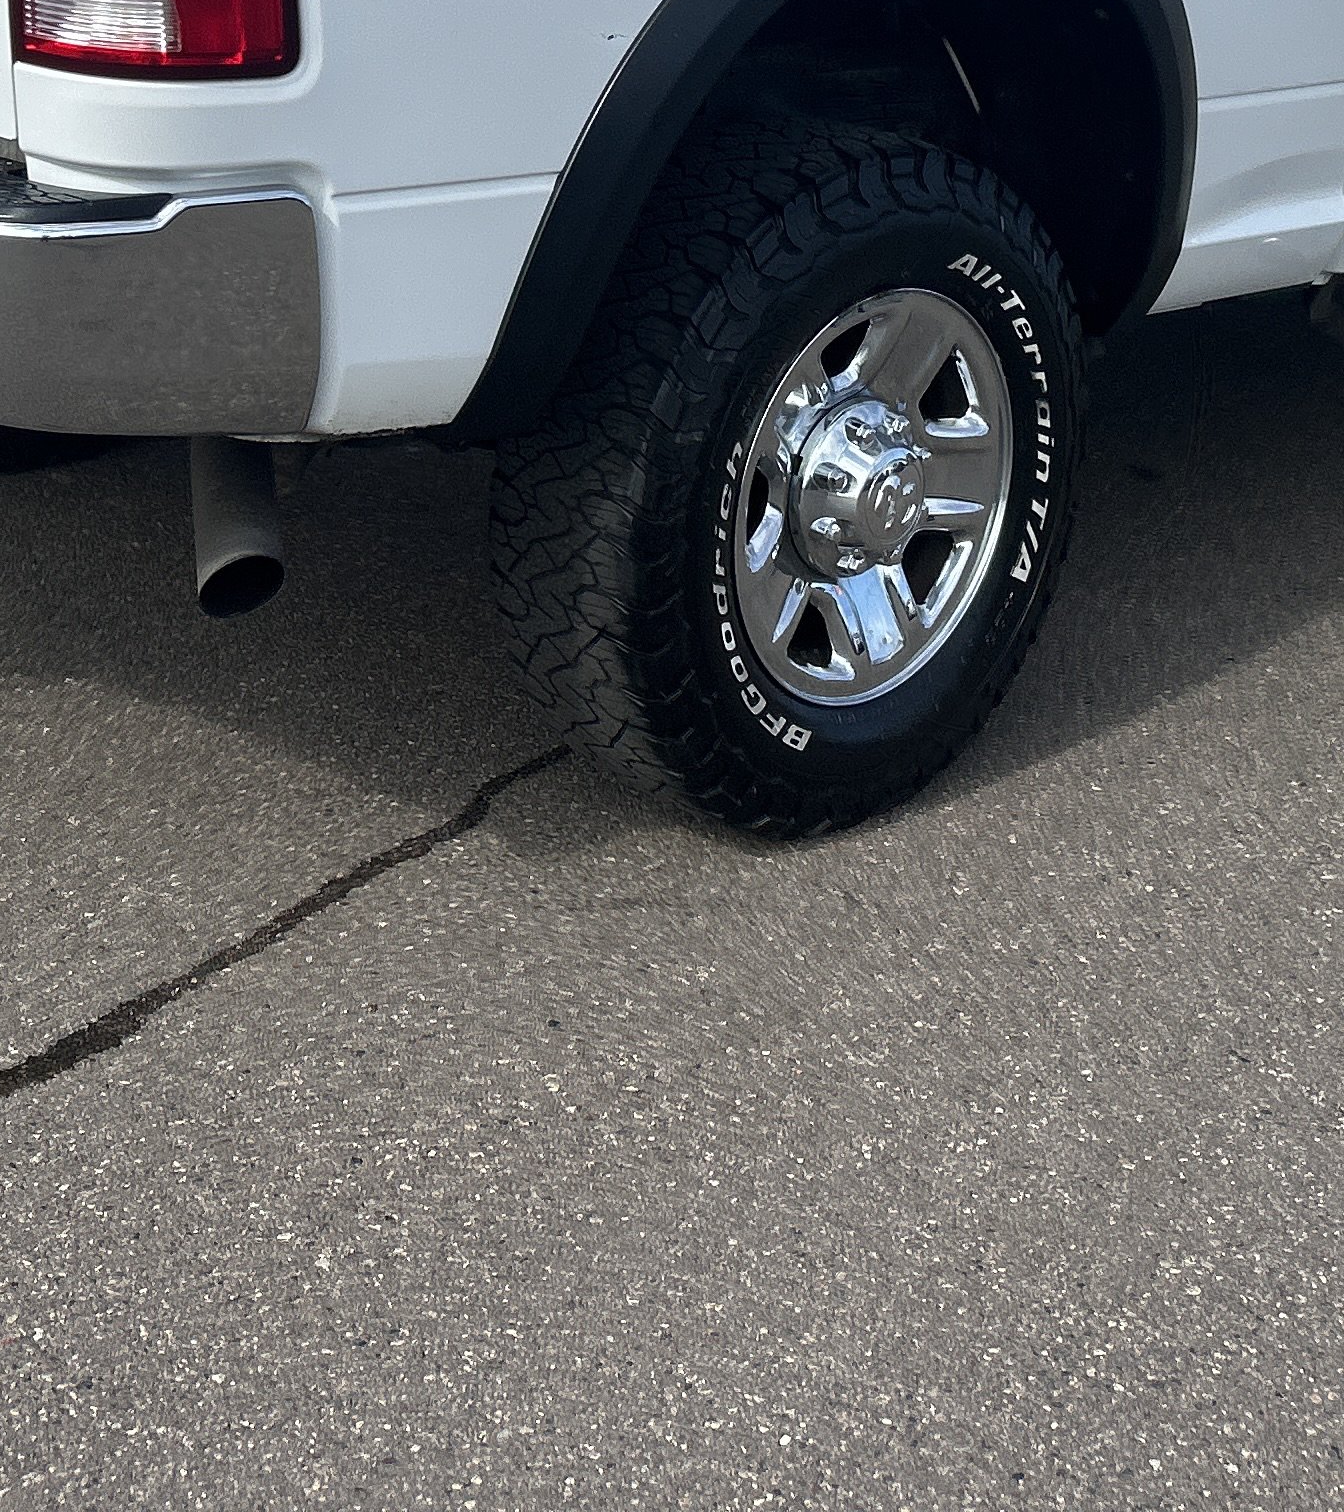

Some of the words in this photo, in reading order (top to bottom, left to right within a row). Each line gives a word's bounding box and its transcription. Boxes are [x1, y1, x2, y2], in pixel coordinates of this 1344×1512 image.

[947, 252, 1055, 484] All-Terrain
[1009, 498, 1050, 584] T/A
[712, 441, 813, 752] BFGoodrich
